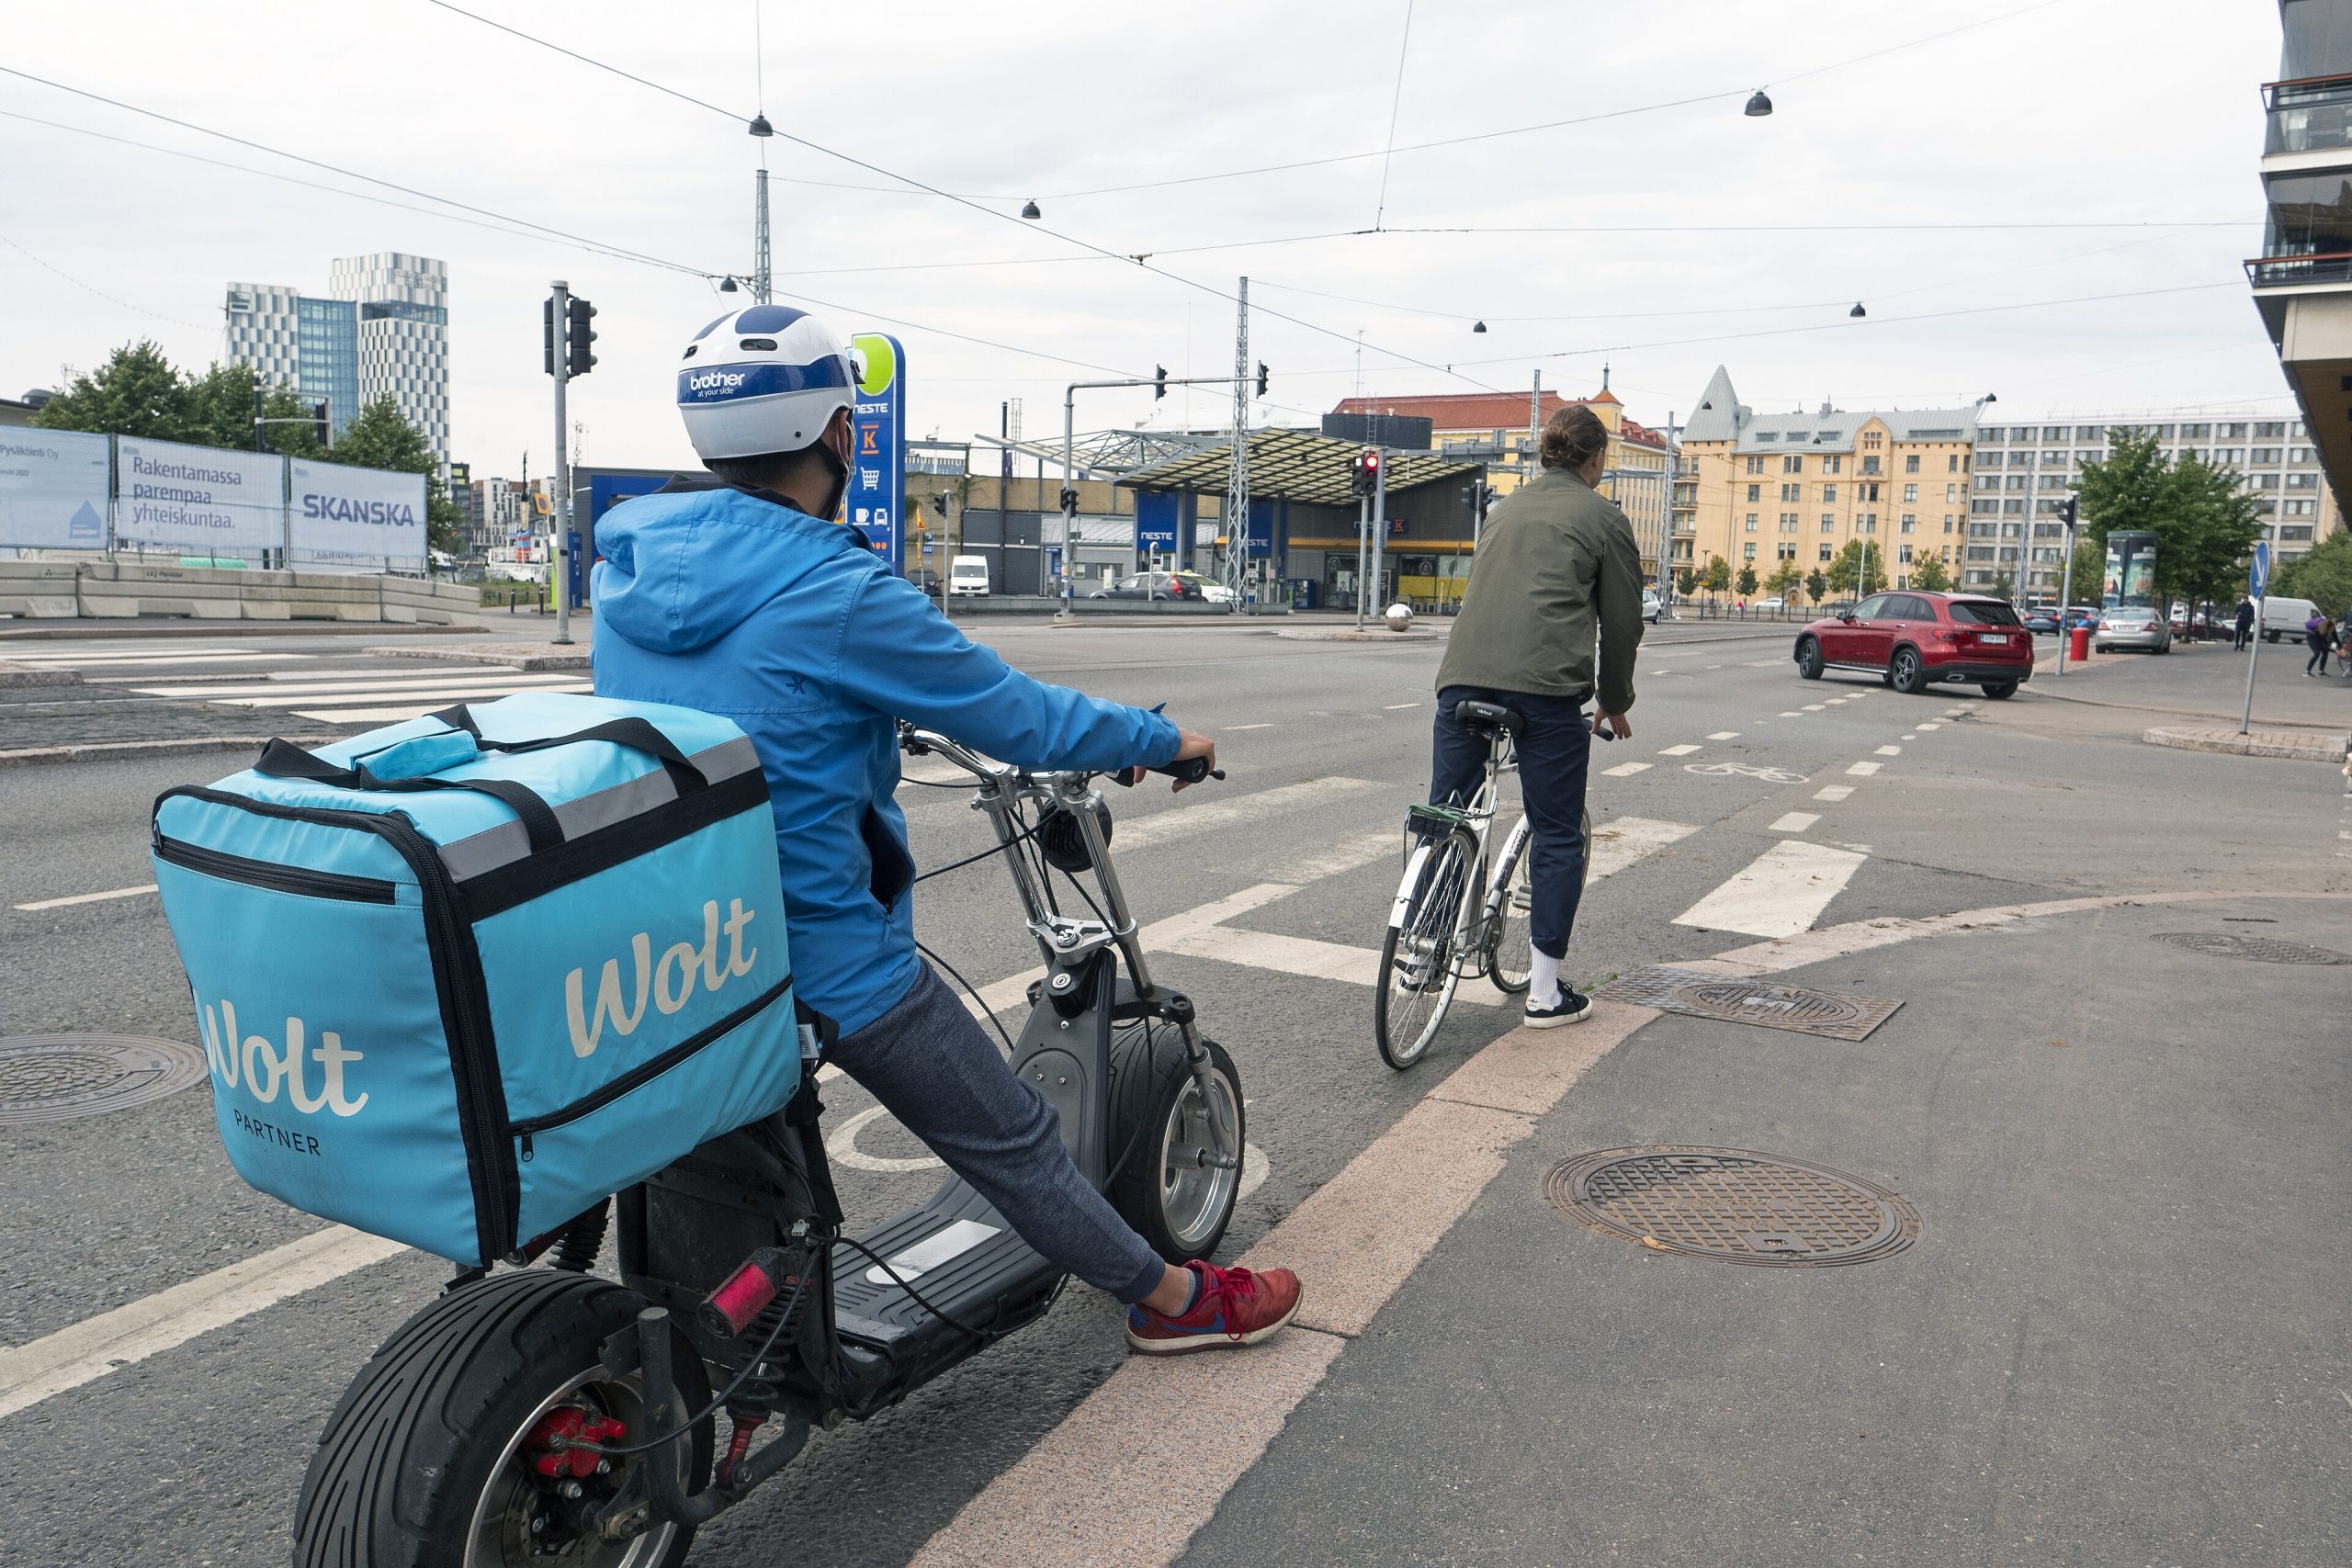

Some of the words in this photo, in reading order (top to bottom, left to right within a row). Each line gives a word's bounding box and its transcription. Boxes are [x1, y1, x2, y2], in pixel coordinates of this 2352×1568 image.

[691, 372, 745, 390] brother
[704, 389, 718, 398] your
[719, 387, 734, 395] side
[863, 430, 877, 449] K
[47, 448, 59, 460] Oy
[133, 457, 242, 485] Rakentamassa
[133, 482, 212, 506] parempaa
[133, 503, 235, 528] yhteiskuntaa.
[303, 494, 414, 526] SKANSKA
[564, 897, 758, 1060] Wolt
[193, 988, 369, 1119] Wolt
[233, 1109, 322, 1158] PARTNER
